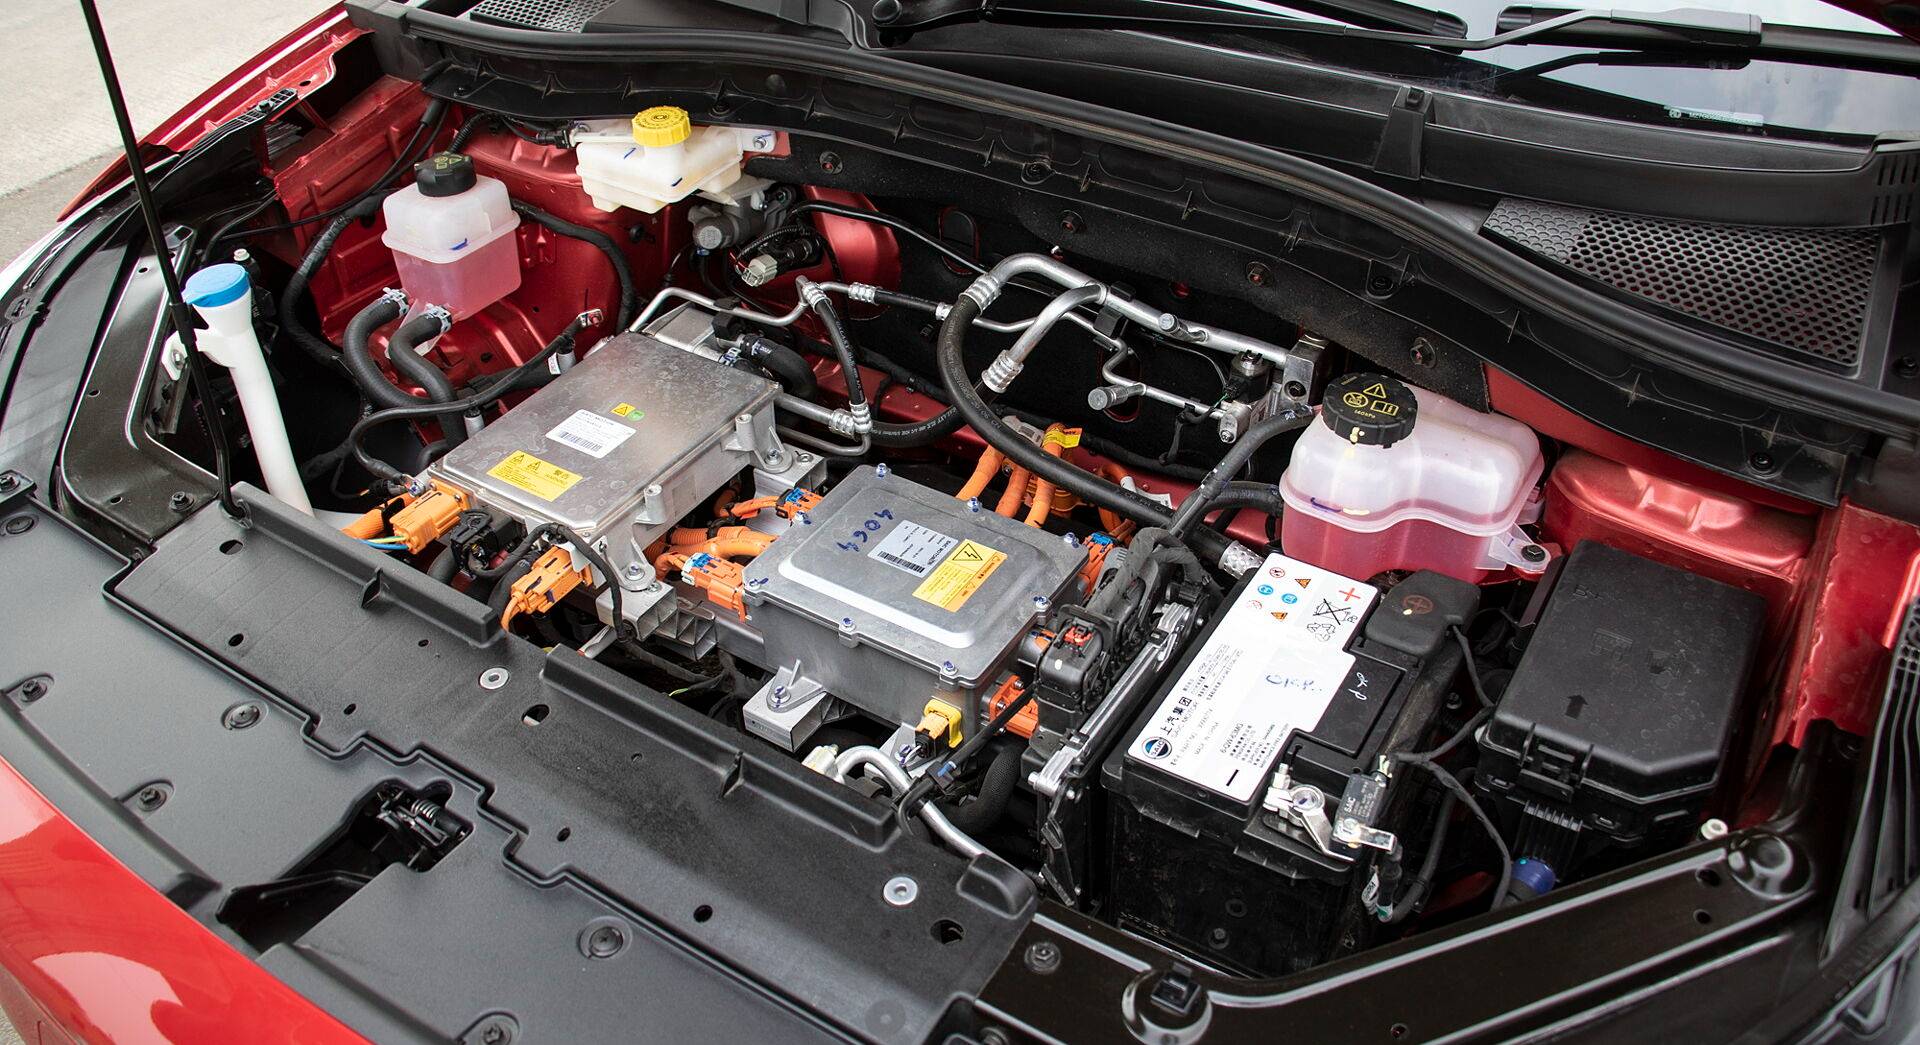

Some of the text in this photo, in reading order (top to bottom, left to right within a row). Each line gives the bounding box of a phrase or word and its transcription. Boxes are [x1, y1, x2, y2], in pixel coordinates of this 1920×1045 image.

[1159, 695, 1193, 735] 上汽集团
[1150, 738, 1166, 757] SAIC
